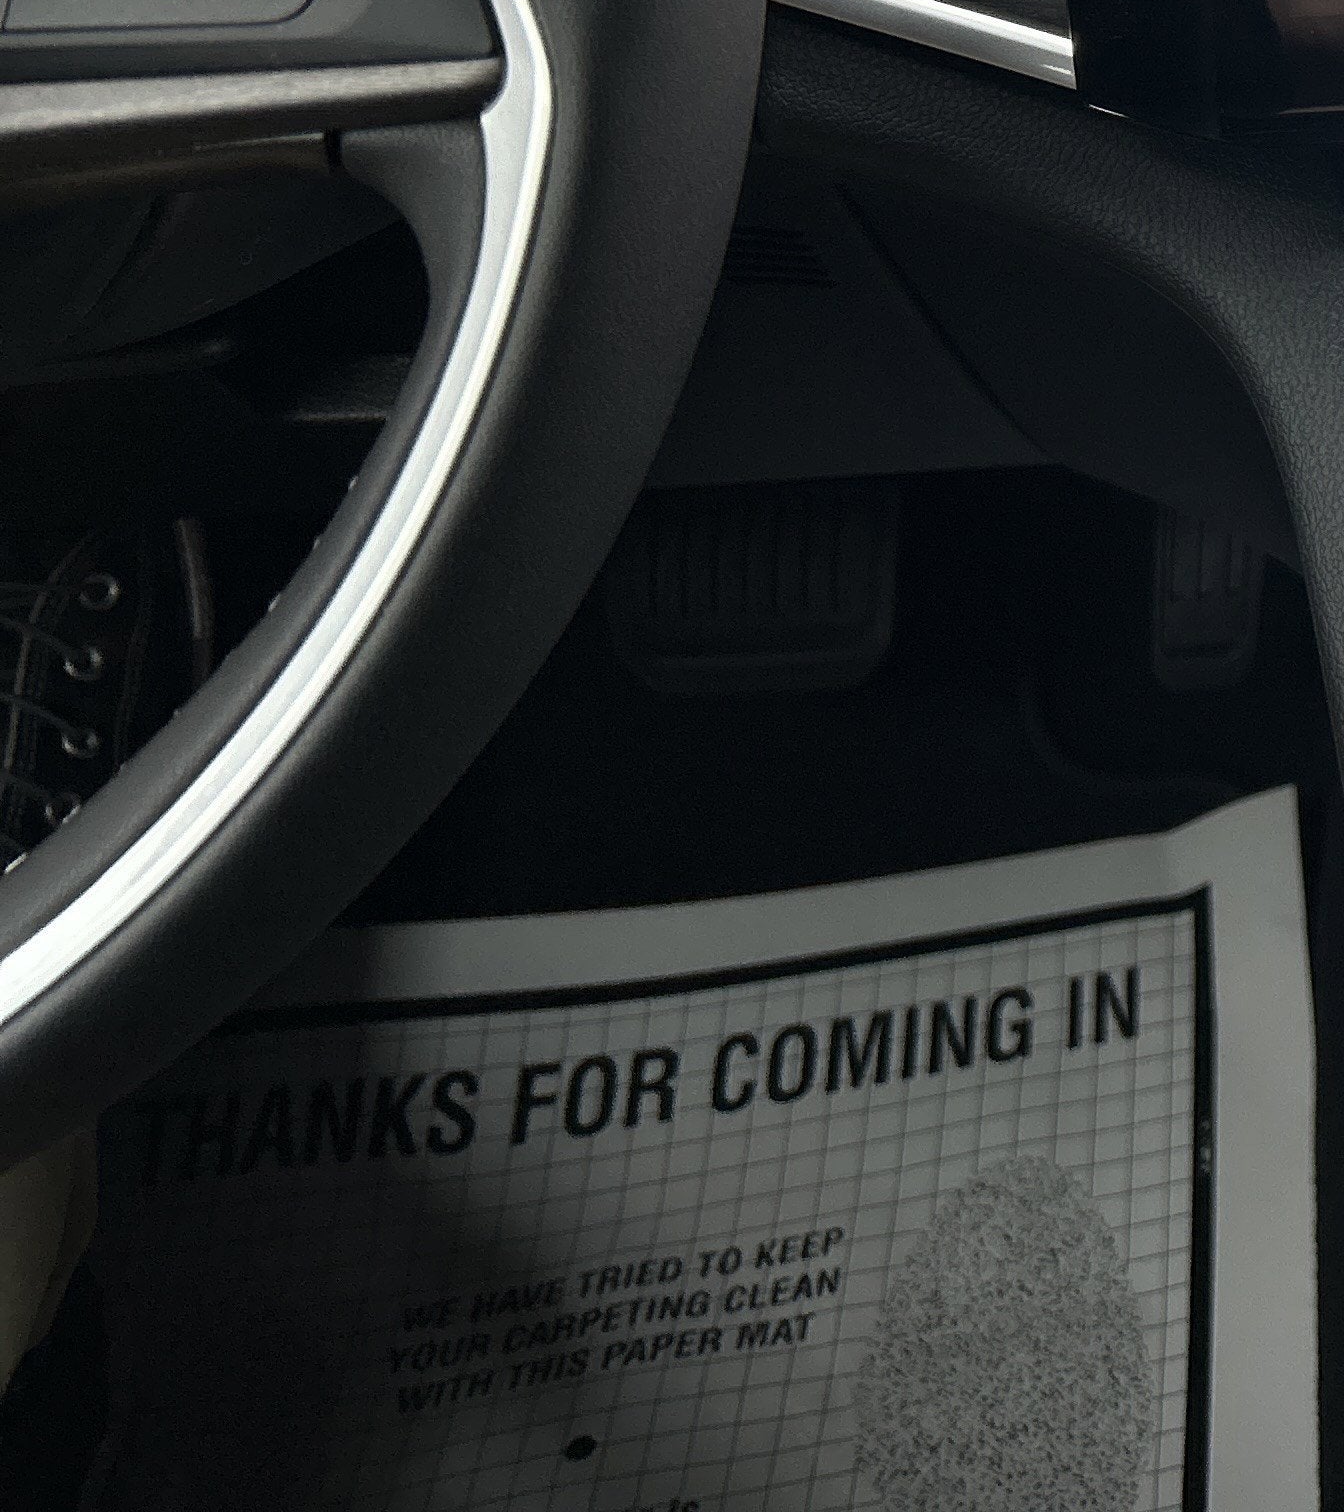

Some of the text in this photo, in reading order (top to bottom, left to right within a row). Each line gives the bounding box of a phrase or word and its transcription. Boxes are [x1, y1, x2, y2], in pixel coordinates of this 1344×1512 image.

[510, 1046, 678, 1148] FOR
[711, 988, 1037, 1115] COMING
[1063, 965, 1142, 1052] IN
[389, 1266, 842, 1376] YOUR CARPETING CLEAN
[469, 1277, 566, 1323] HAVE
[579, 1255, 684, 1300] TRIED
[698, 1243, 743, 1279] TO
[753, 1226, 846, 1269] KEEP
[507, 1348, 591, 1392] THIS
[599, 1329, 723, 1373] PAPER
[735, 1311, 816, 1353] MAT
